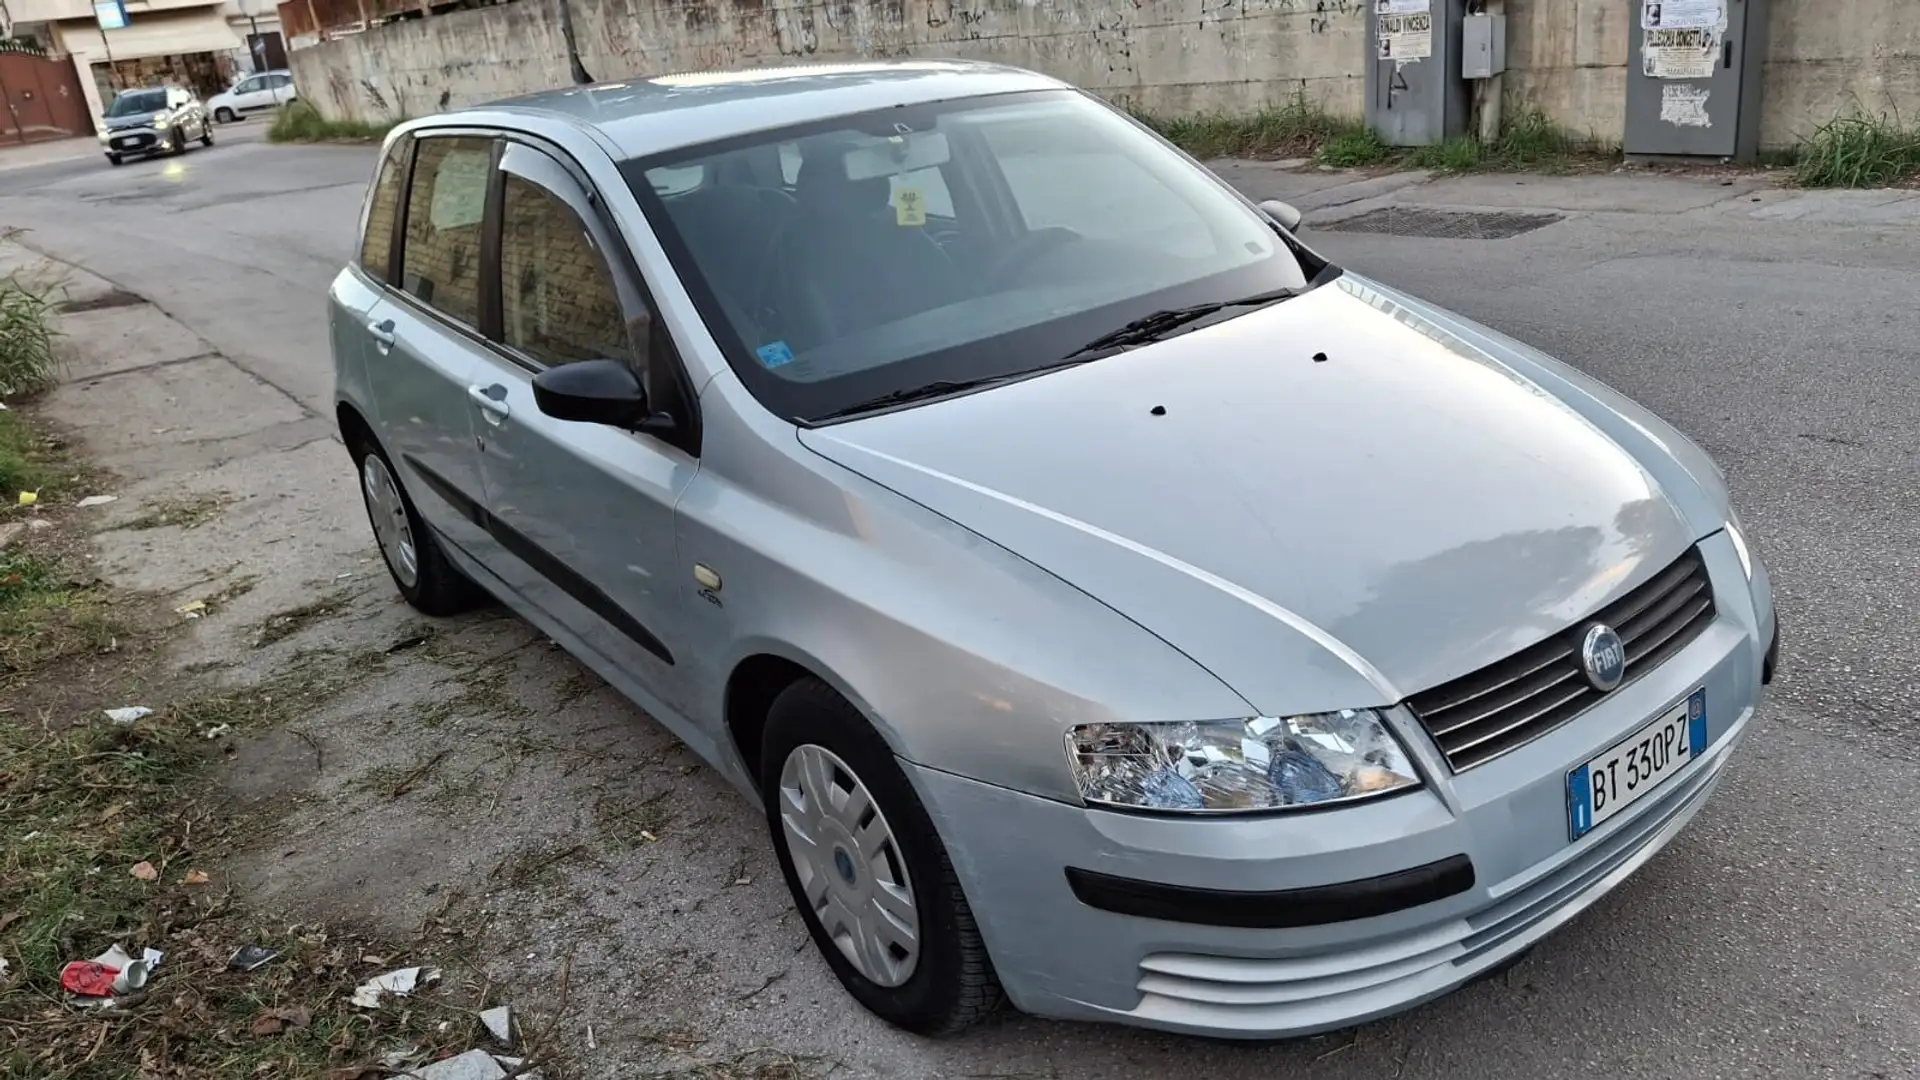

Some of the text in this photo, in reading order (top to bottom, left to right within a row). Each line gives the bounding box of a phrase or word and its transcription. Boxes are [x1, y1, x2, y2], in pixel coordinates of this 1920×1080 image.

[1593, 642, 1620, 674] FIAT
[1592, 759, 1619, 811] BT
[1626, 713, 1688, 790] 330PZ
